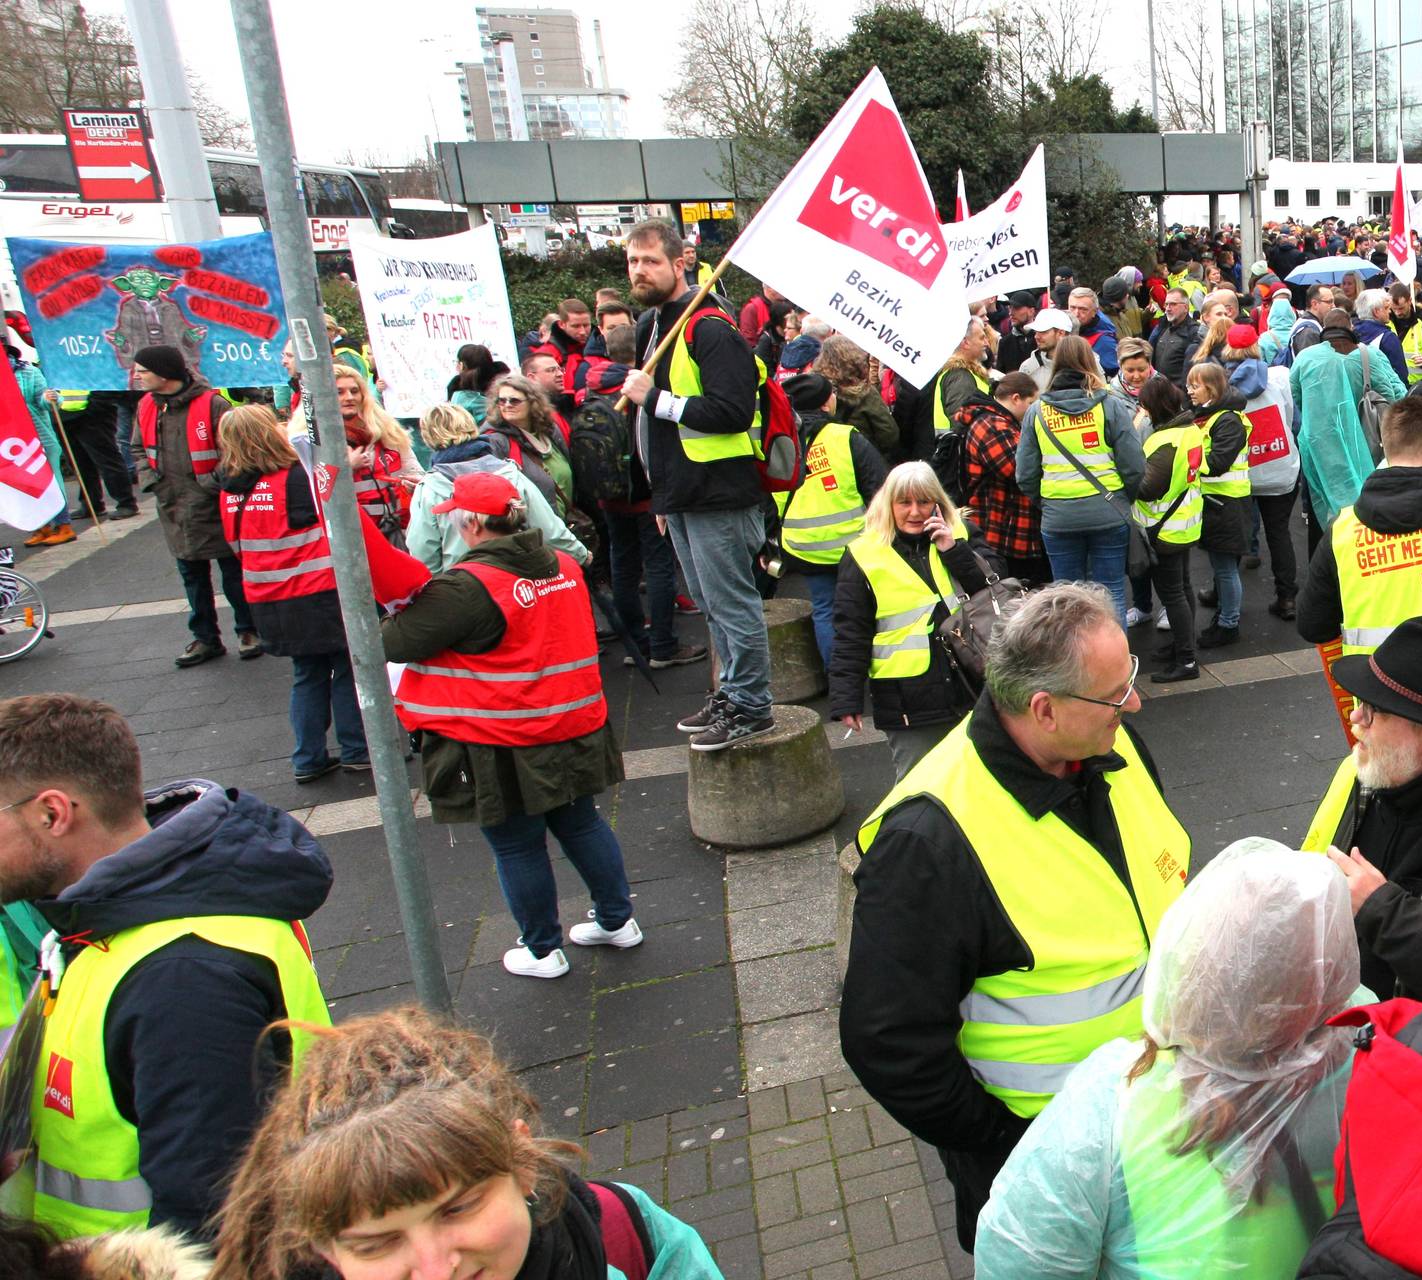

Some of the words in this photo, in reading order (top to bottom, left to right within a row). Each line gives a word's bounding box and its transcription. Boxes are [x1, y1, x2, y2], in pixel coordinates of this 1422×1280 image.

[71, 114, 137, 127] Laminat
[88, 129, 124, 137] DEPOT
[42, 204, 114, 218] Engel
[828, 174, 940, 267] ver.di
[311, 219, 349, 249] Enge
[188, 270, 265, 306] BEZAHLEN
[845, 269, 903, 316] Bezirk
[189, 297, 209, 313] DU
[423, 312, 473, 341] PATIENT
[828, 292, 921, 364] Ruhr-West
[1047, 416, 1066, 430] EHT
[1069, 412, 1095, 426] MEHR
[1357, 543, 1396, 570] GEHT
